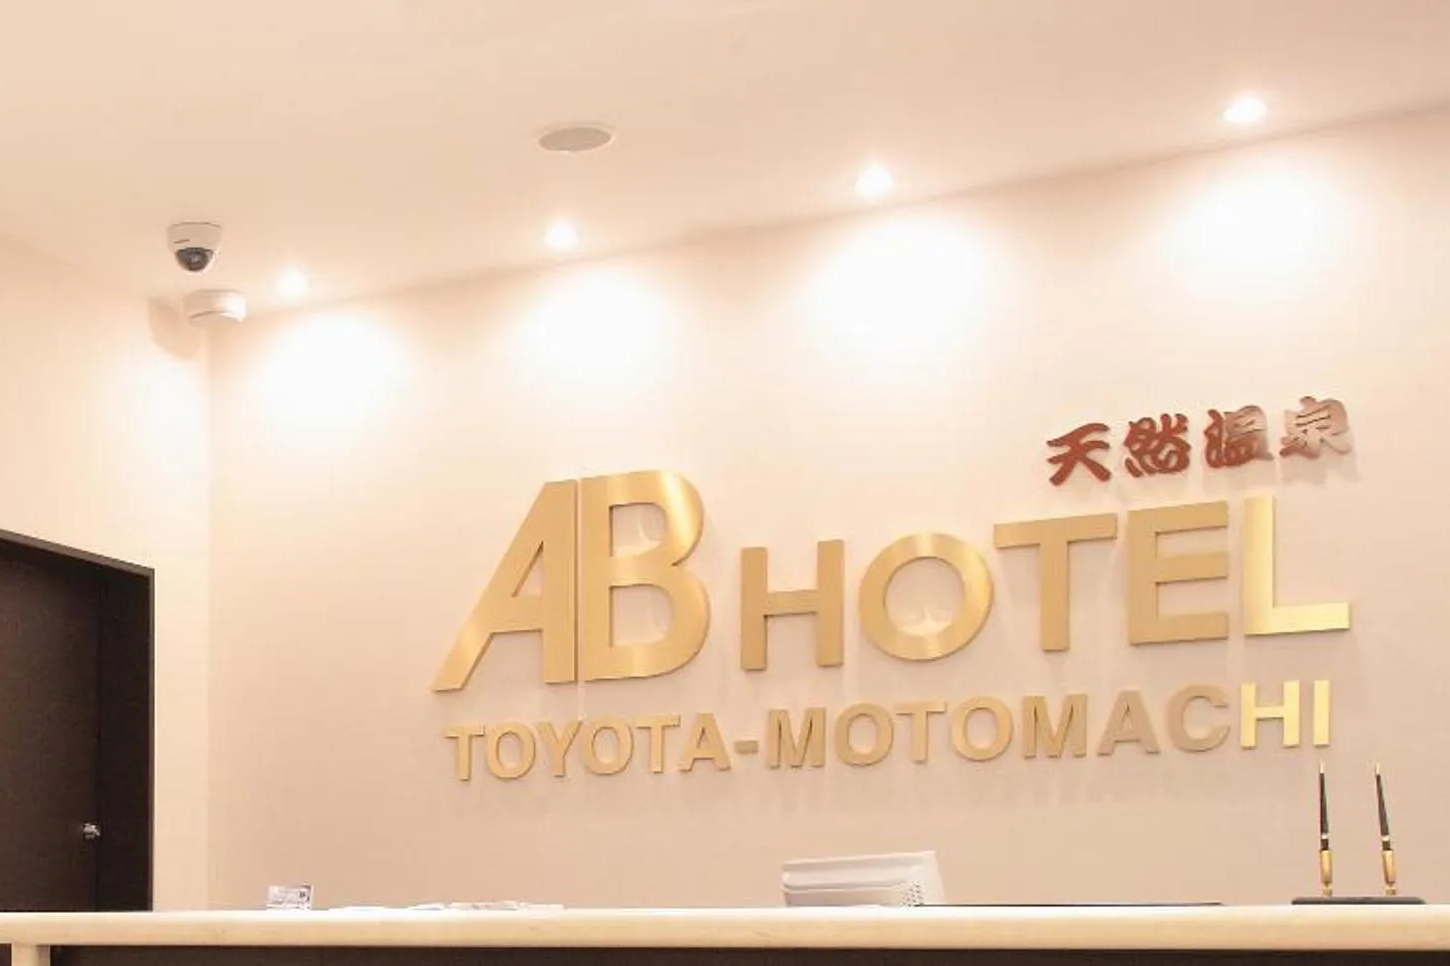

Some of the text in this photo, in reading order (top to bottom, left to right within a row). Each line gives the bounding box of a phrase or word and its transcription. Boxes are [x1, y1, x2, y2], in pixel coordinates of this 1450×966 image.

[1047, 397, 1352, 486] 天然温泉
[432, 469, 1351, 692] AB HOTEL
[445, 679, 1331, 781] TOYOTA-MOTOMACHI
